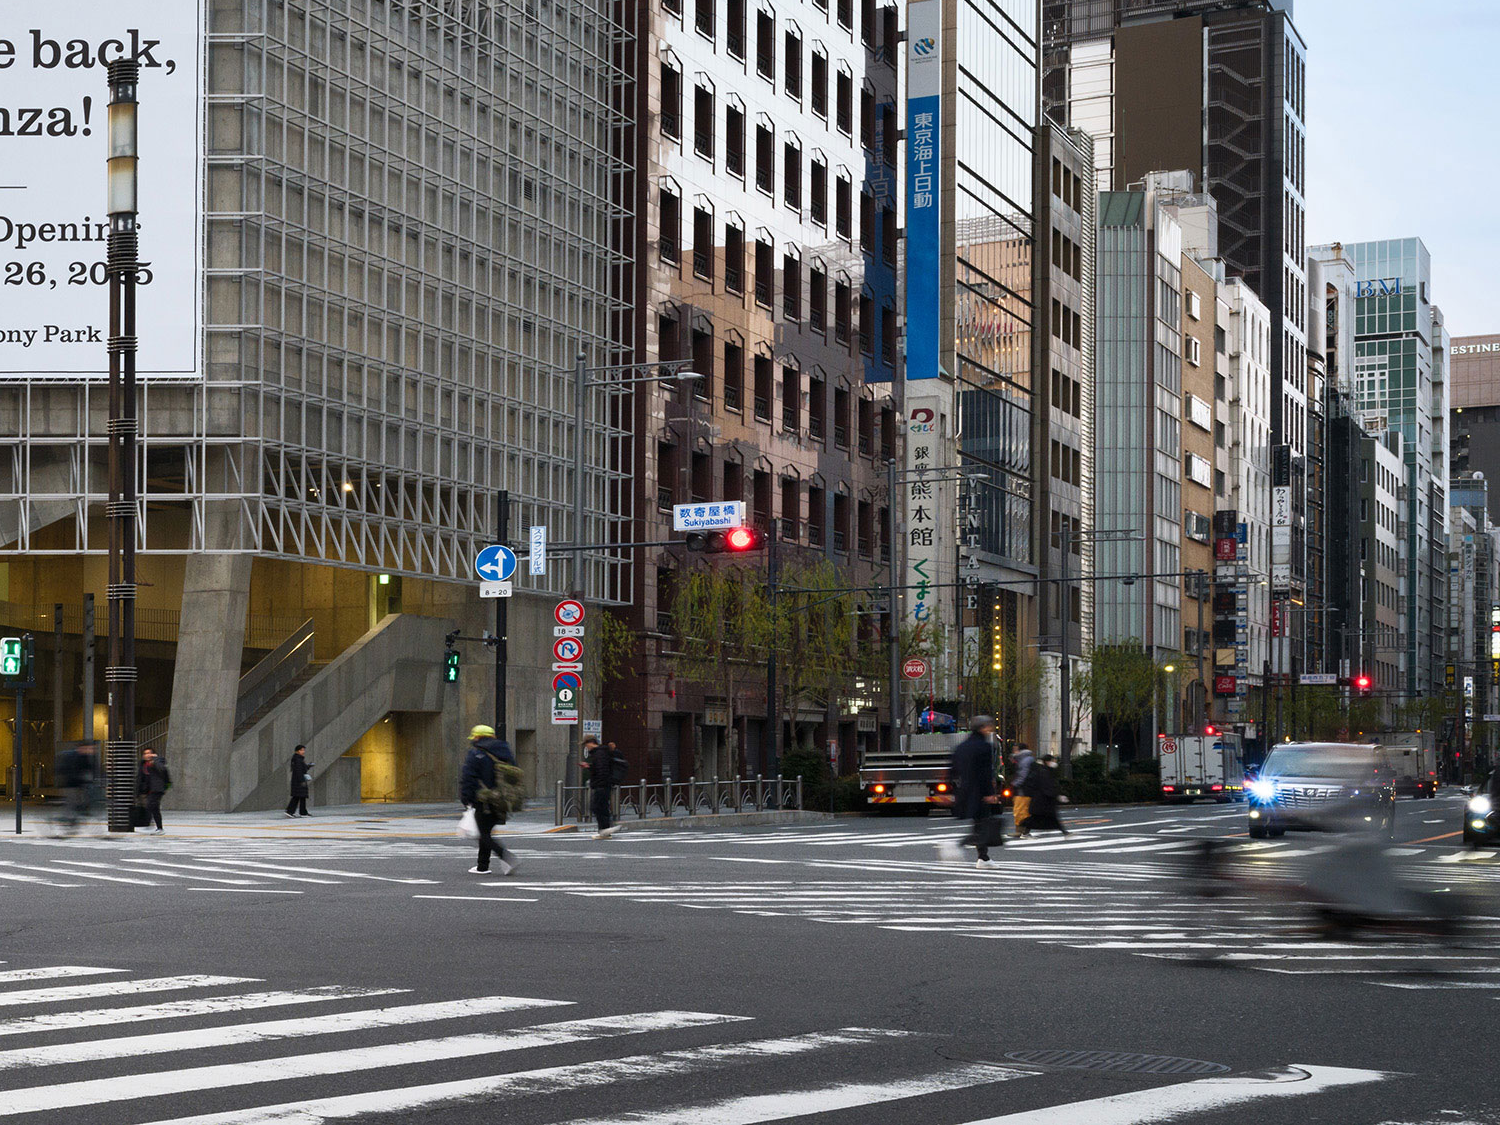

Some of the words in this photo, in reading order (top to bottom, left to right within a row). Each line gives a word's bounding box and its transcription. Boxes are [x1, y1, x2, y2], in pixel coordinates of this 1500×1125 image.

[29, 28, 177, 75] back,
[913, 112, 933, 209] 東京海上日動
[4, 260, 57, 290] 26,
[67, 261, 154, 286] 205
[43, 324, 102, 344] Park
[680, 505, 735, 518] 数寄屋橋
[684, 517, 731, 527] Sukiyabashi
[534, 528, 542, 573] スクランブル式
